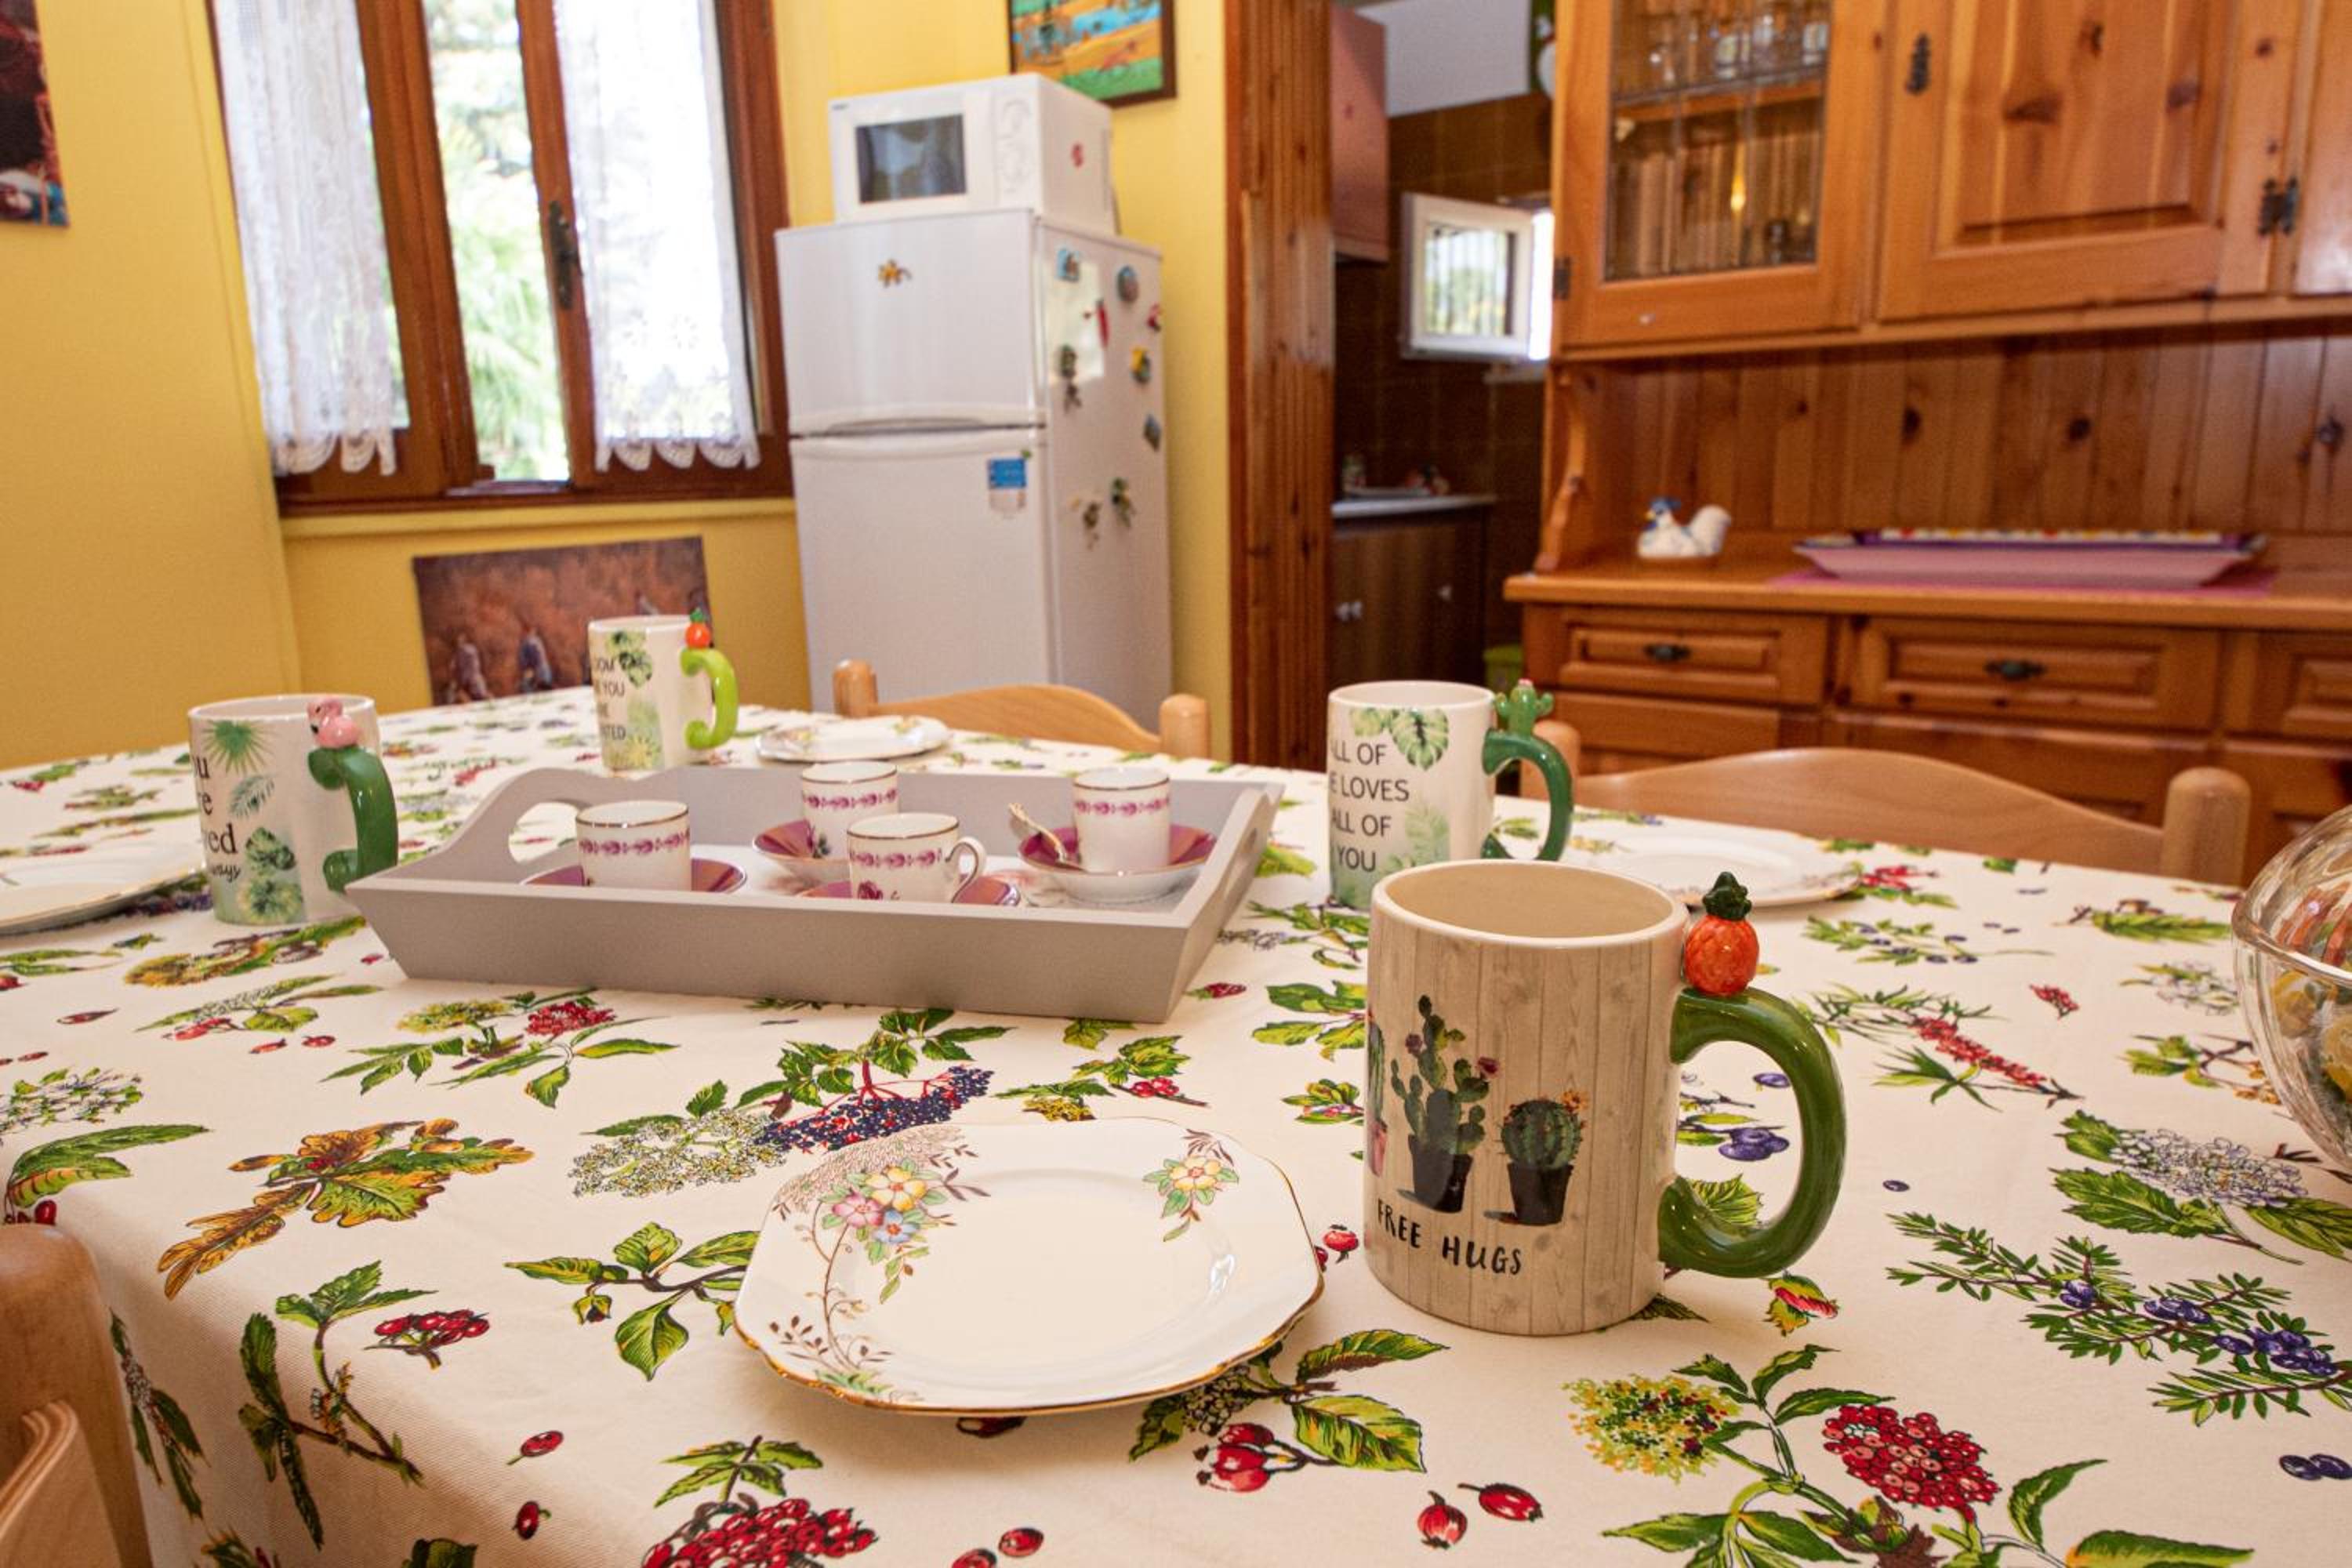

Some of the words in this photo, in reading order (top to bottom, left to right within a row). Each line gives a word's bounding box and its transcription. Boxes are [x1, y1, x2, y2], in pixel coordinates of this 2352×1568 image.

[602, 680, 626, 698] YOU
[1357, 742, 1388, 766] OF
[1341, 775, 1410, 802] LOVES
[1361, 814, 1392, 837] OF
[1337, 844, 1376, 873] YOU
[1377, 1198, 1421, 1249] FREE
[1441, 1236, 1523, 1276] HUGS
